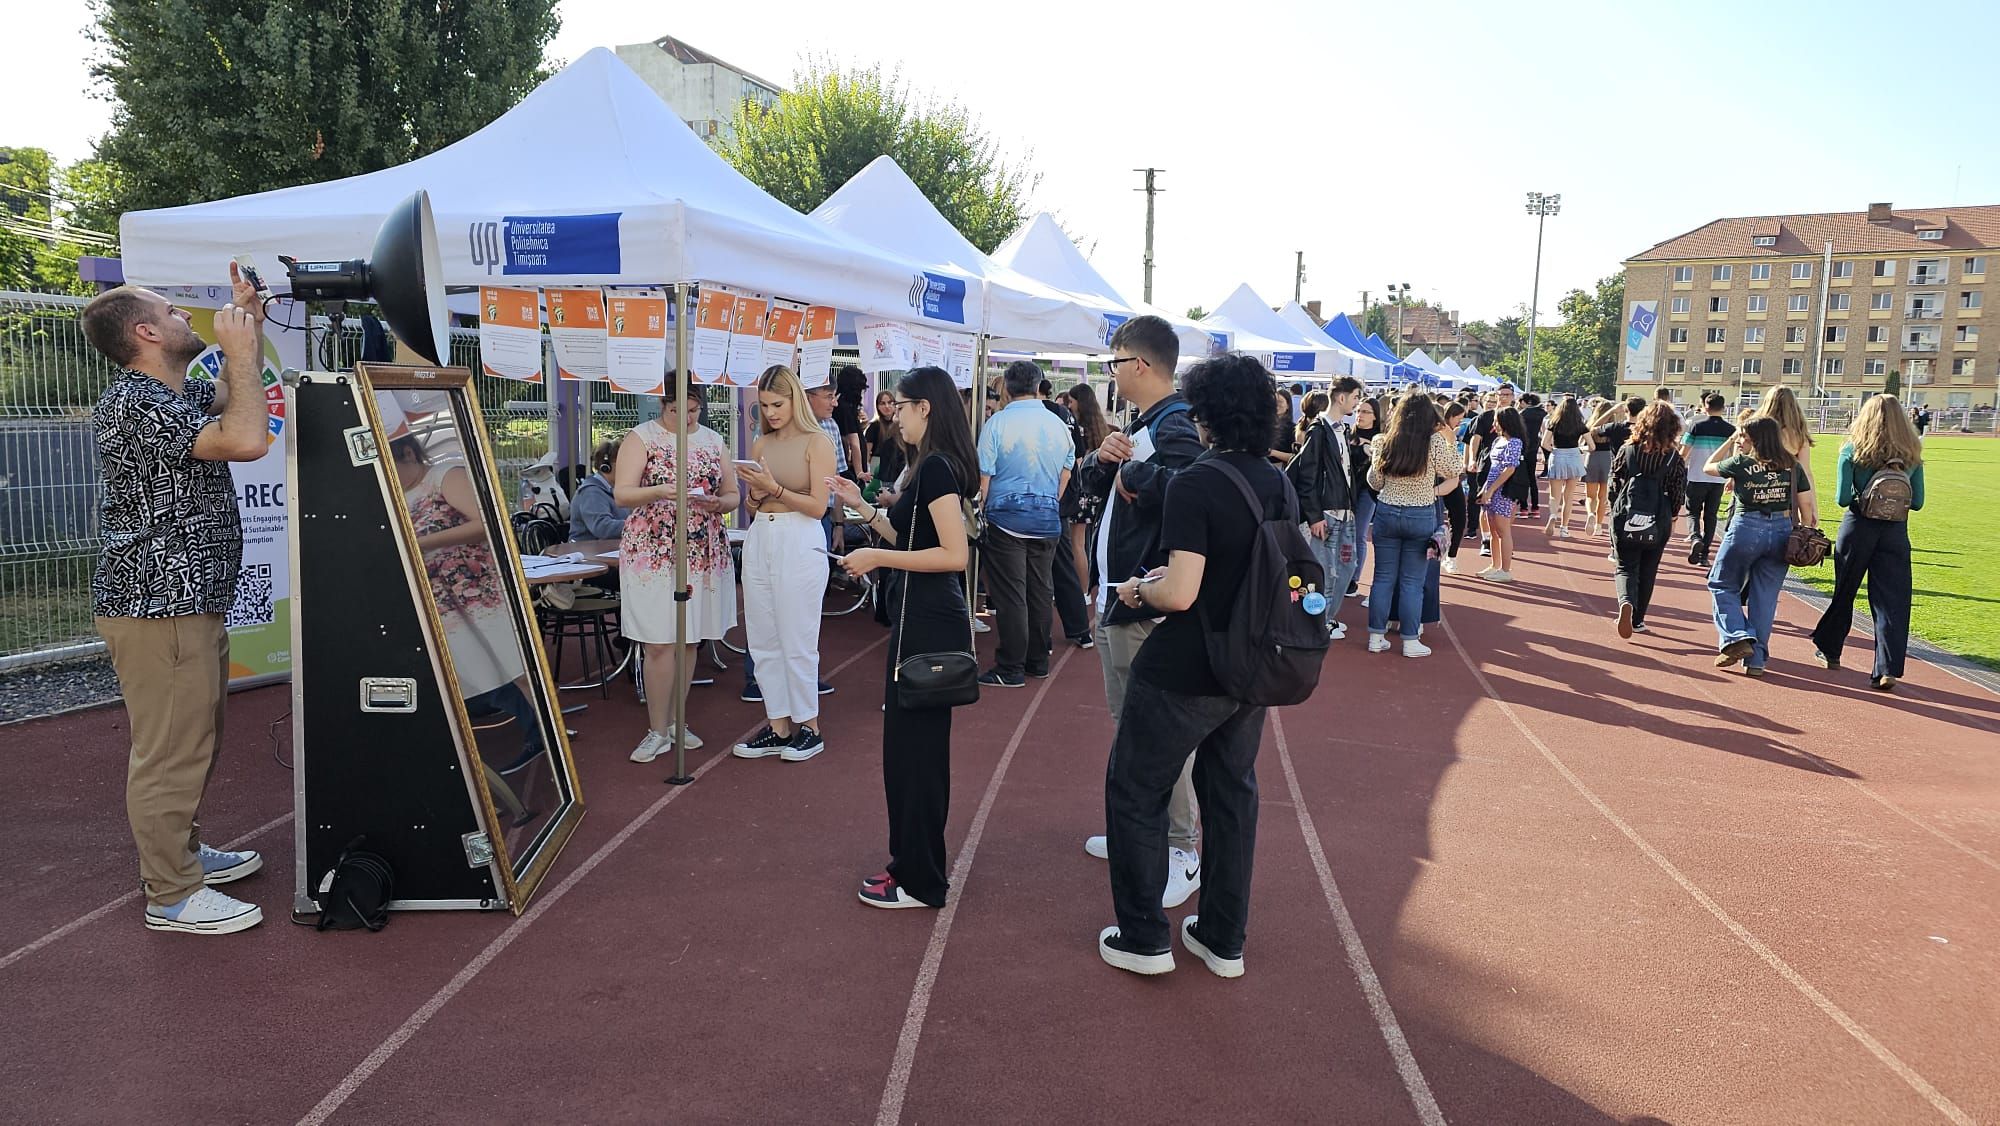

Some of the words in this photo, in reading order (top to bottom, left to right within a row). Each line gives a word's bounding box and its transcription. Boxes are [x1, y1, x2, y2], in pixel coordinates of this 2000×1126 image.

[511, 221, 556, 235] Universitatea
[511, 236, 549, 250] Politehnica
[253, 515, 281, 524] Engaging
[248, 524, 284, 533] Sustainable
